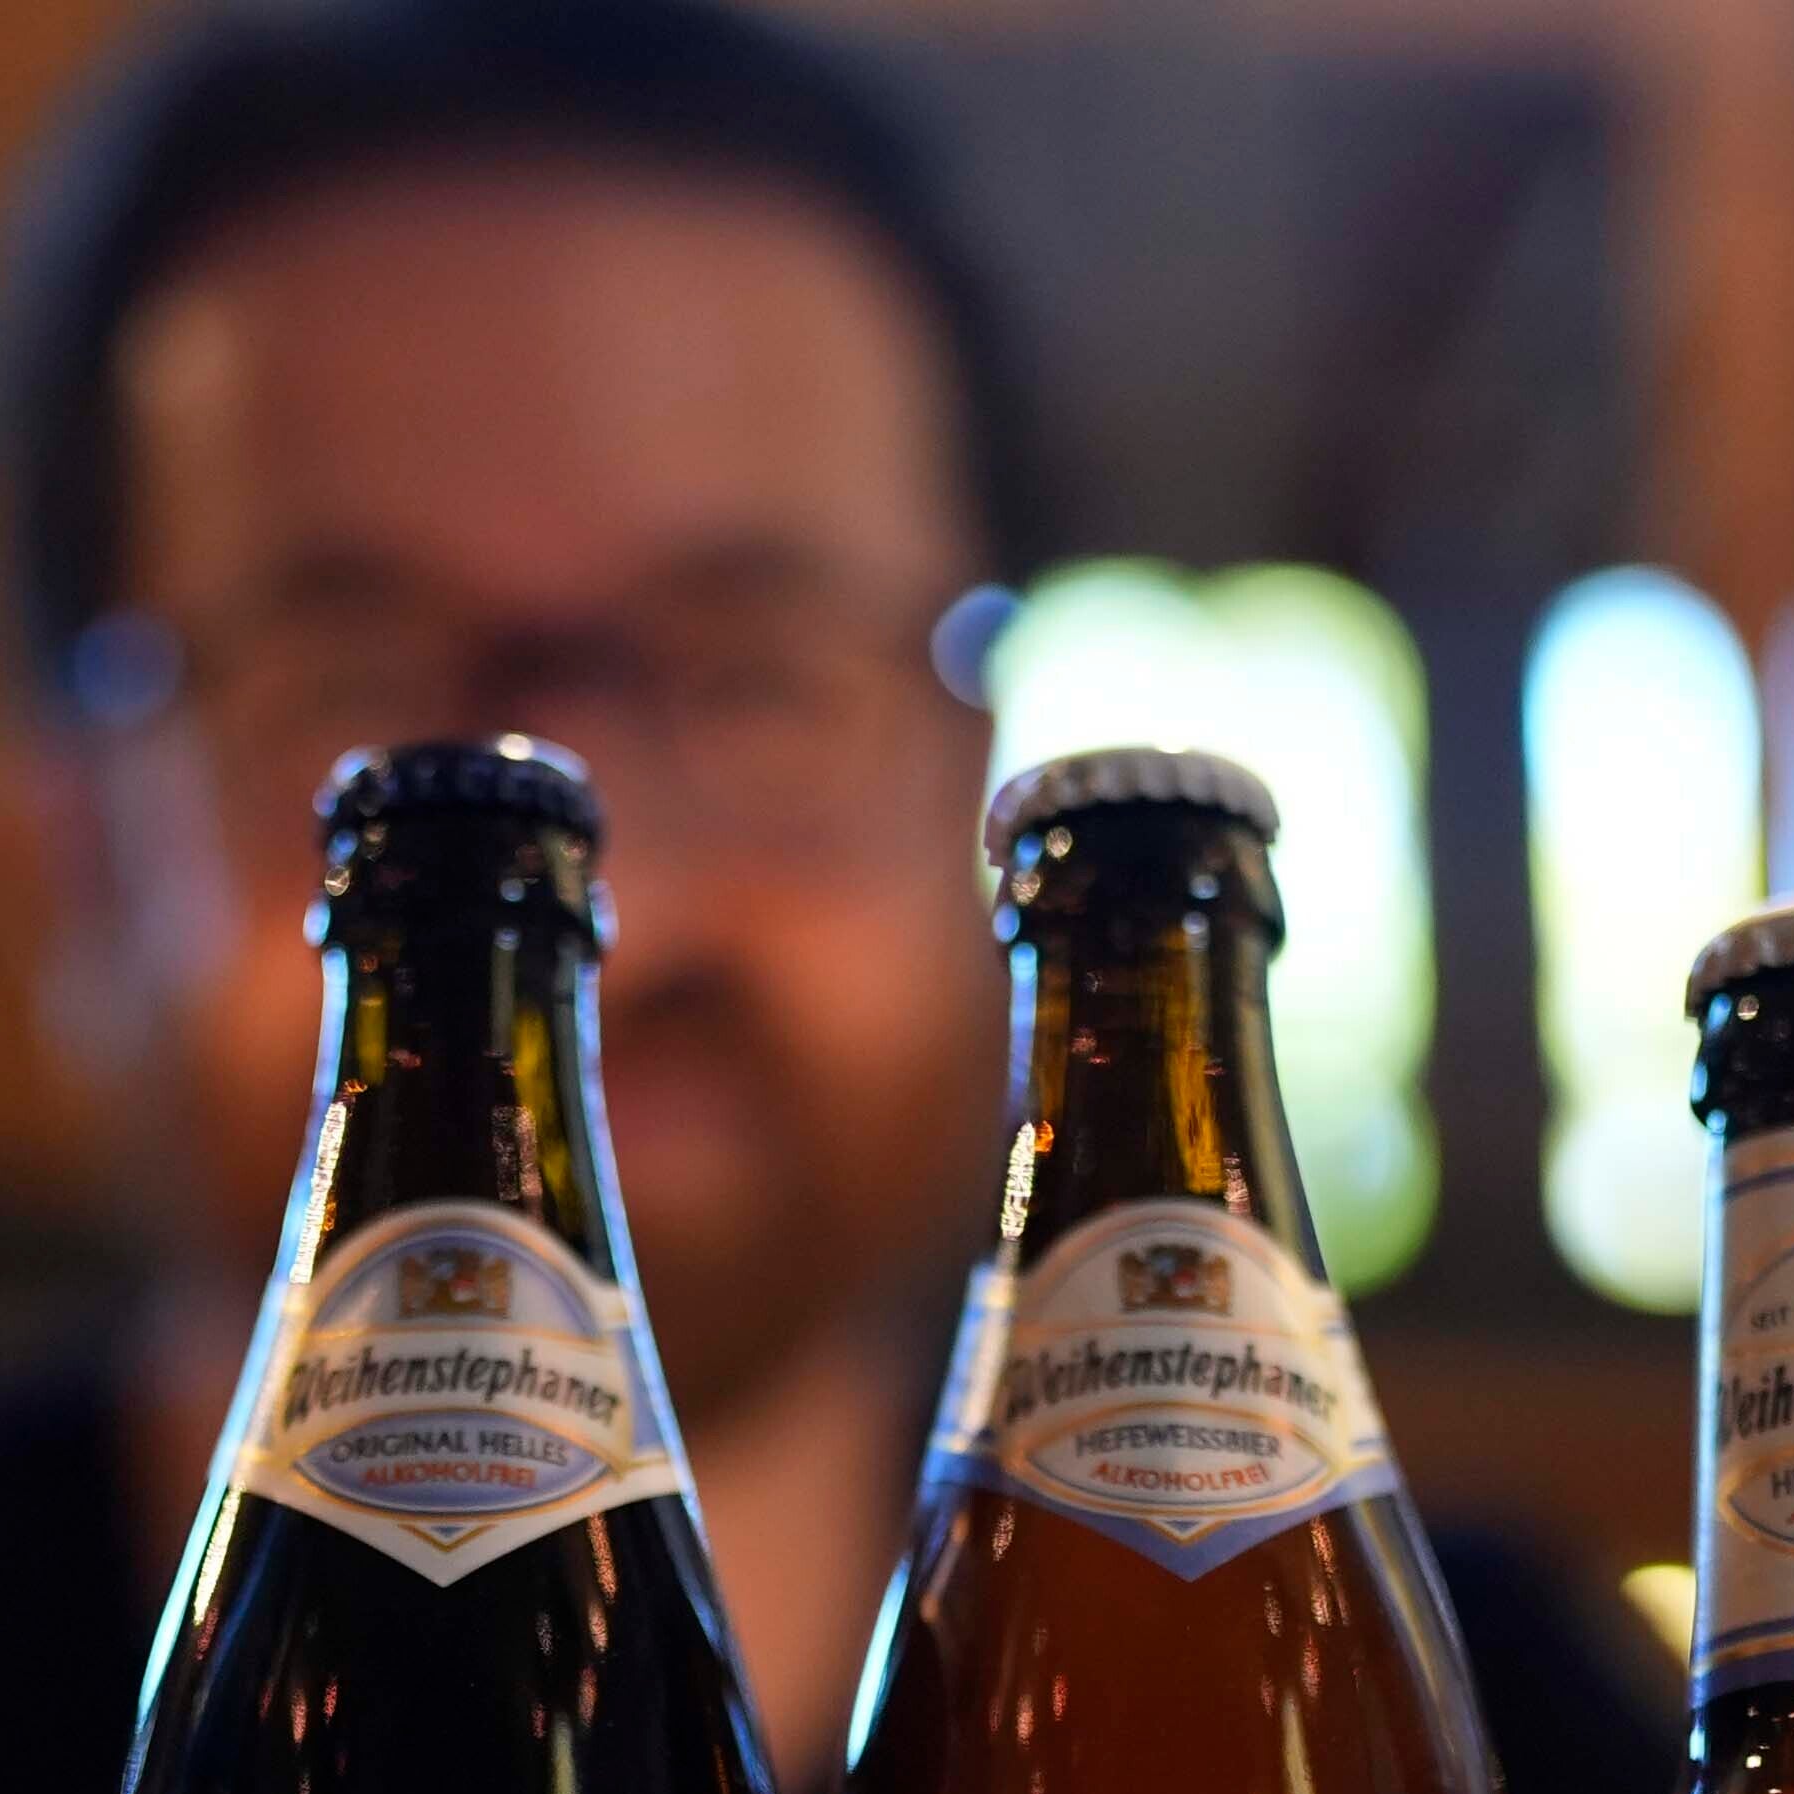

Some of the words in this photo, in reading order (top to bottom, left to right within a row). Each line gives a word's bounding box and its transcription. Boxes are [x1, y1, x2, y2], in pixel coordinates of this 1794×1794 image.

[329, 1429, 468, 1465] ORIGINAL
[479, 1431, 570, 1467] HELLES
[1074, 1422, 1282, 1460] HEFEWEISSBIER
[1090, 1462, 1271, 1491] ALKOHOLFREI
